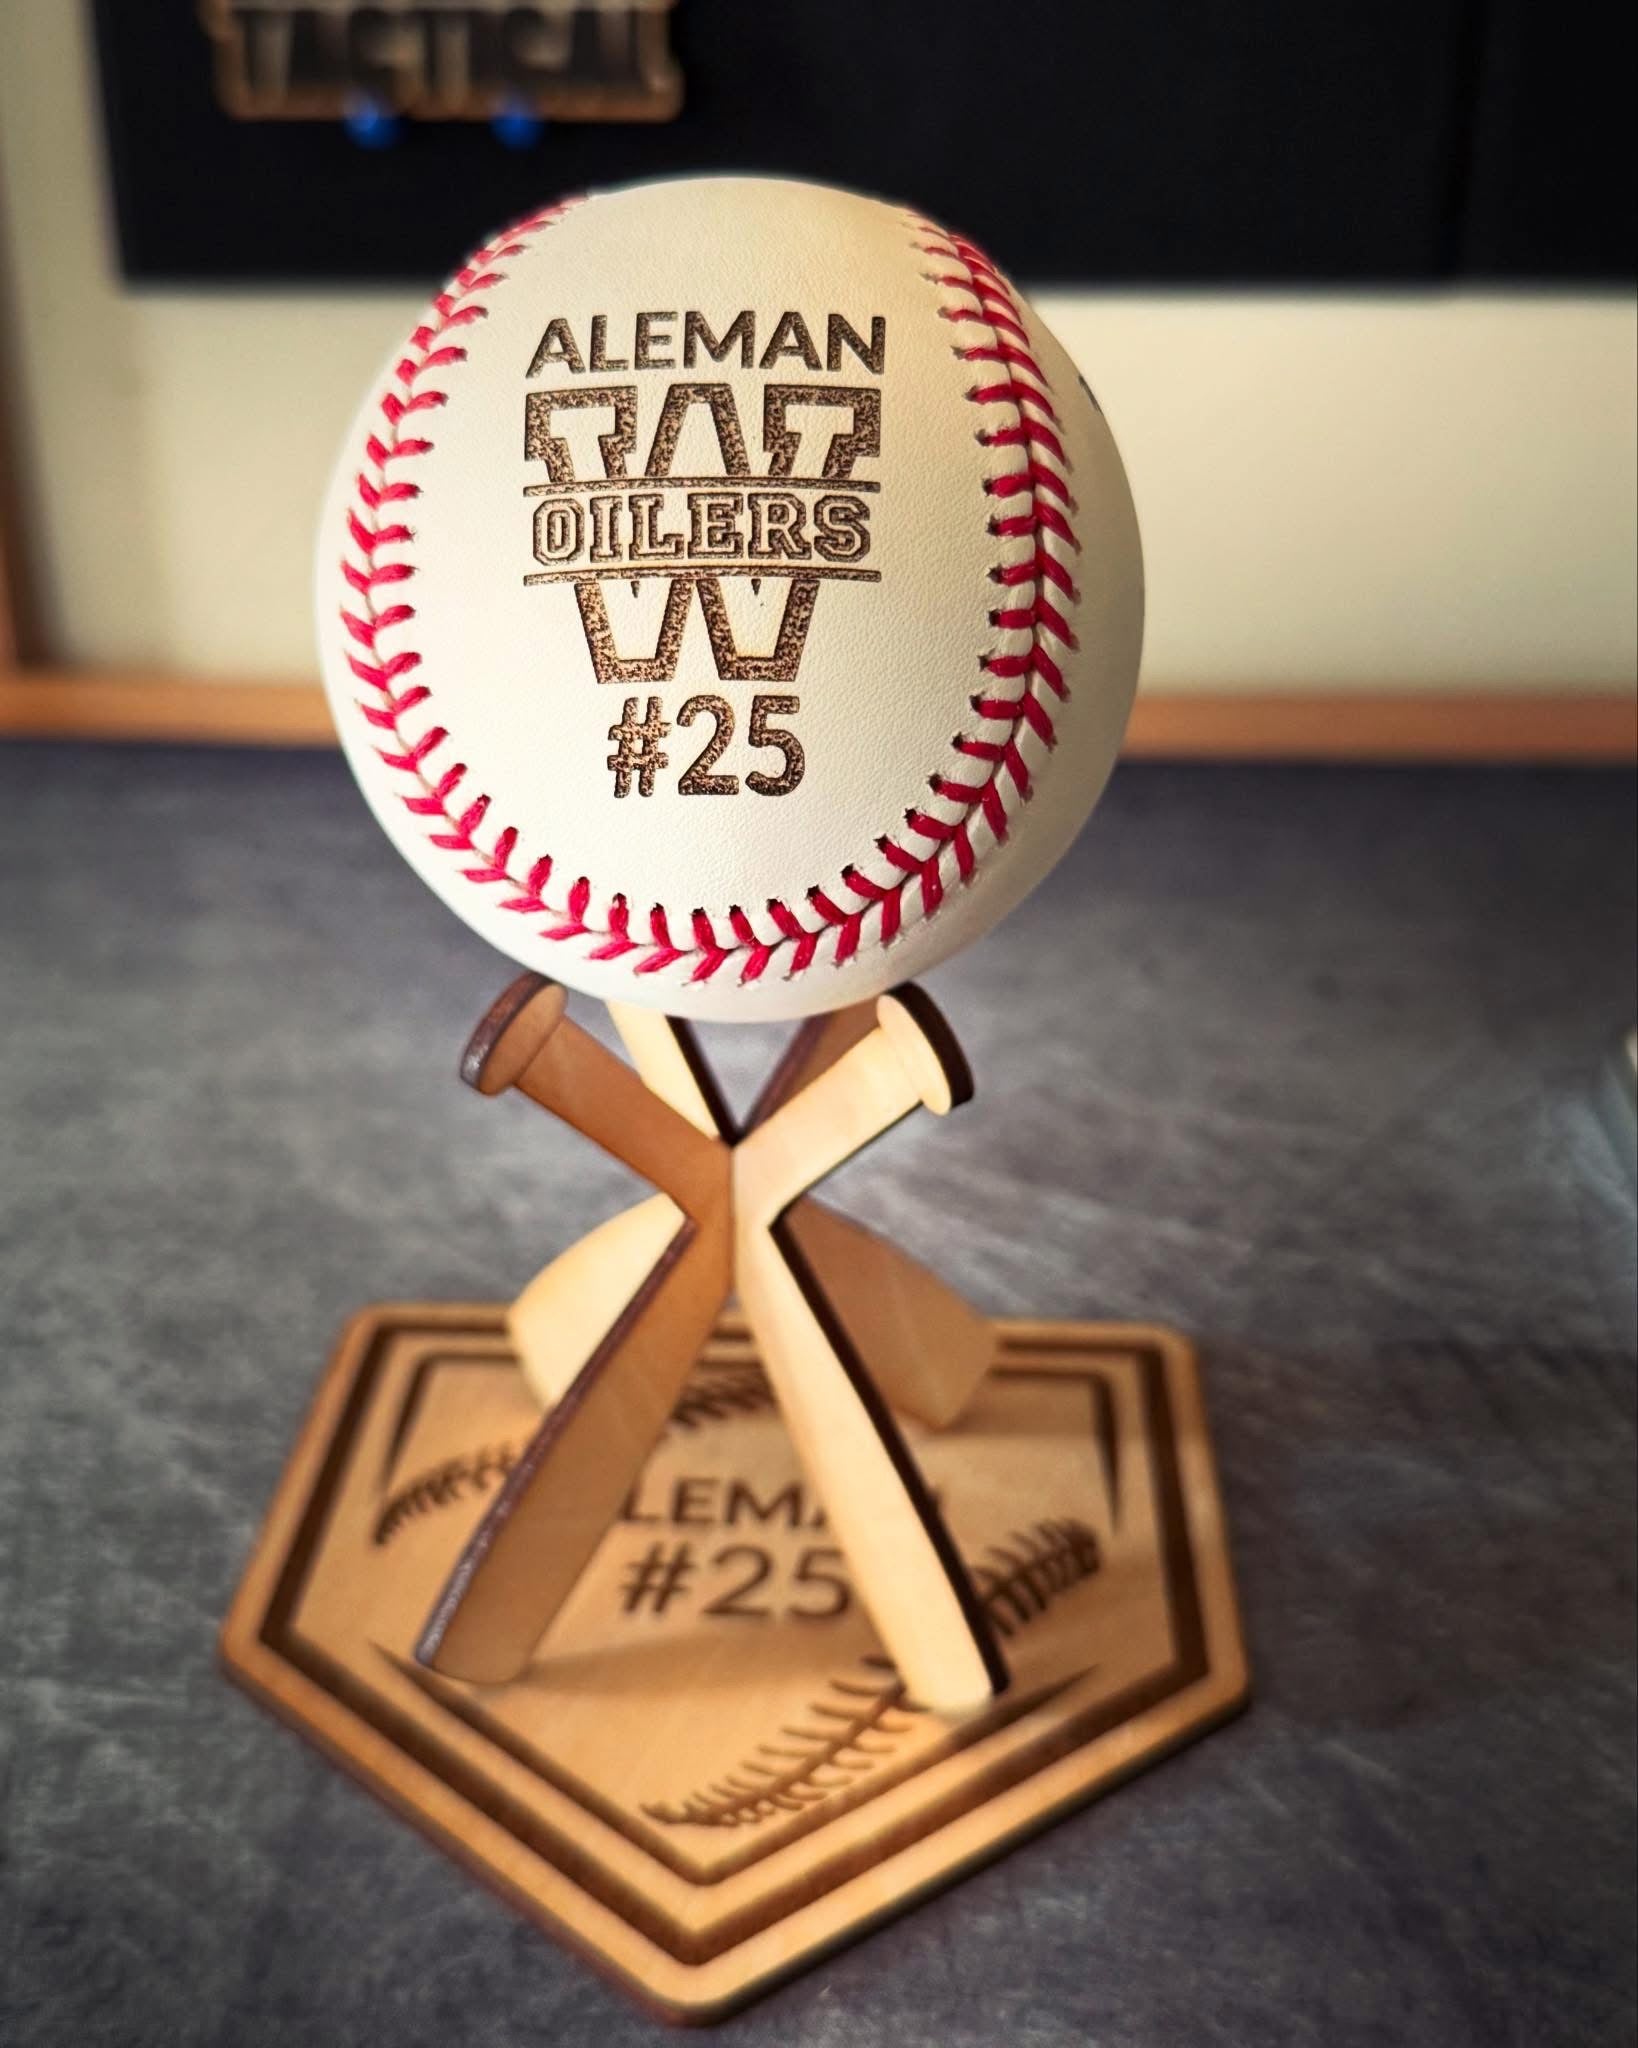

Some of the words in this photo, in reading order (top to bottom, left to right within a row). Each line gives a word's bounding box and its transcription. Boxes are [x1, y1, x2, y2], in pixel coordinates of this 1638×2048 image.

[526, 311, 886, 378] ALEMAN
[533, 492, 871, 566] OILERS
[606, 695, 806, 798] #25
[619, 1541, 856, 1622] #25
